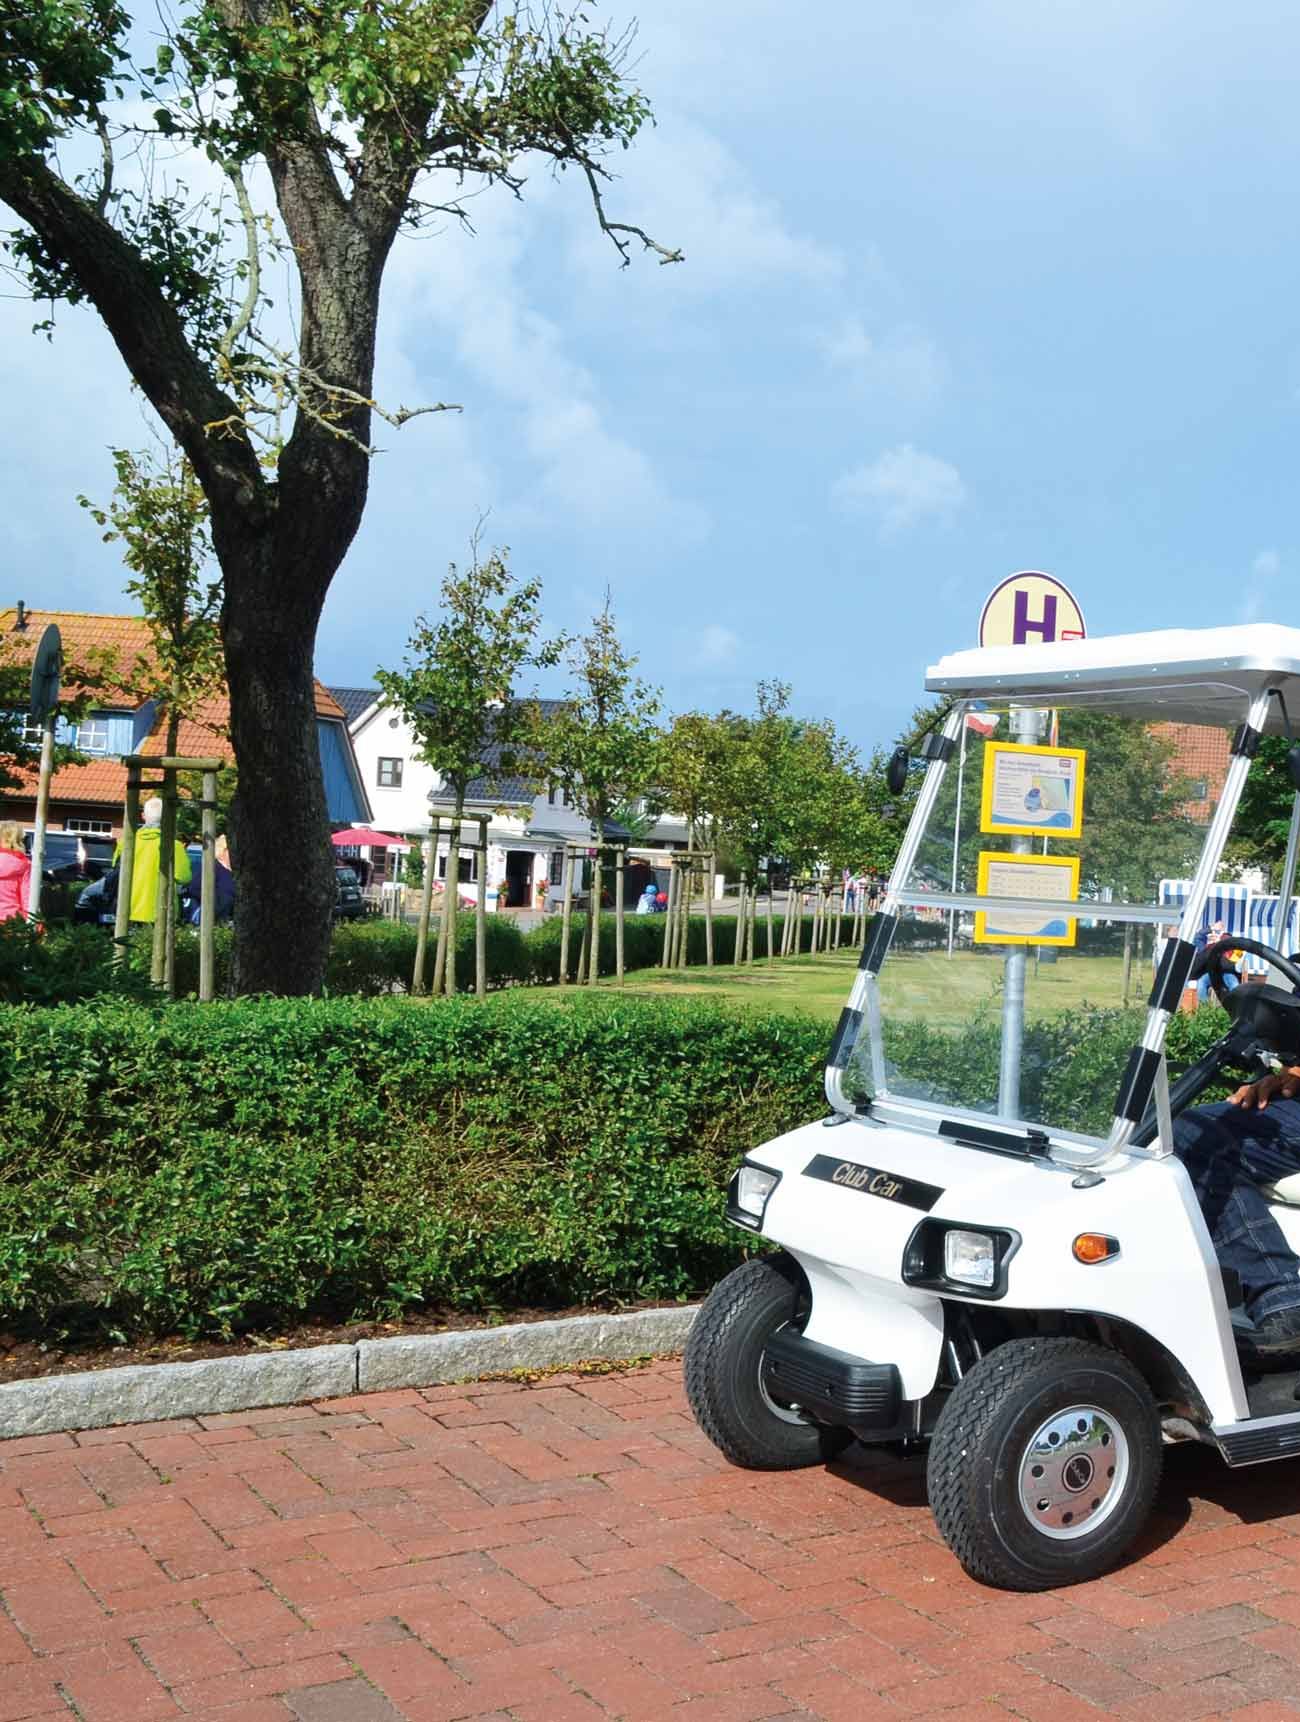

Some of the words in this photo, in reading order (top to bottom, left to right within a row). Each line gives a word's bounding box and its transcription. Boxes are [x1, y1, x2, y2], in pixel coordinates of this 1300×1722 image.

[1013, 590, 1057, 645] H
[832, 1162, 868, 1188] Club
[869, 1173, 903, 1198] Car
